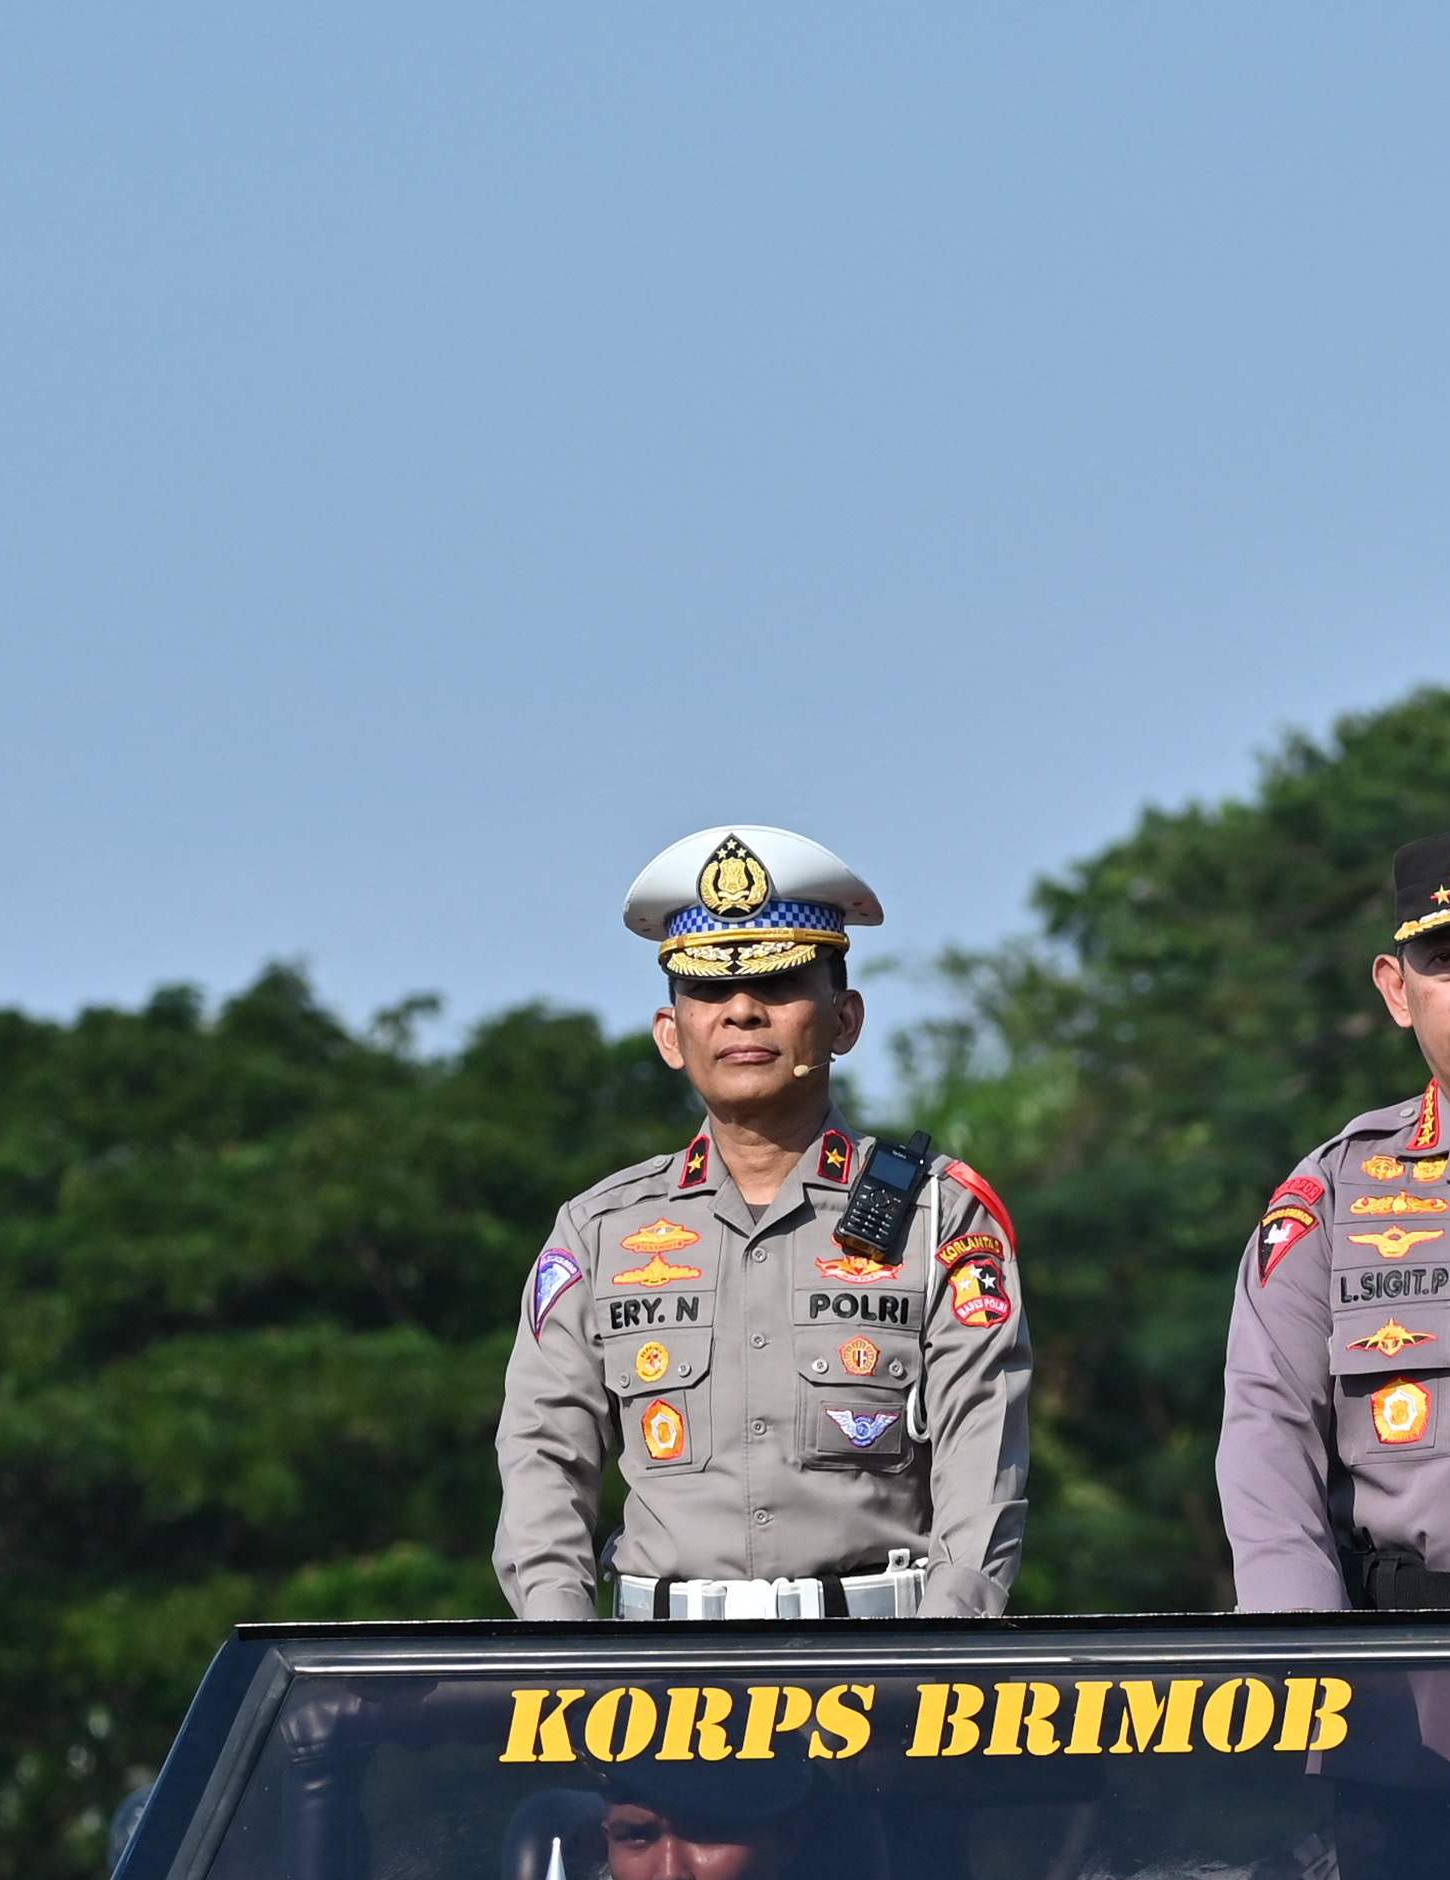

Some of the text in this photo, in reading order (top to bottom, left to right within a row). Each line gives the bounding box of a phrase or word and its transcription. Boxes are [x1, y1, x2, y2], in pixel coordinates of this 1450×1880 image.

[1340, 1267, 1449, 1303] L.SIGIT.P
[610, 1296, 699, 1330] ERY. N
[810, 1293, 909, 1325] POLRI
[498, 1676, 1353, 1764] KORPS BRIMOB
